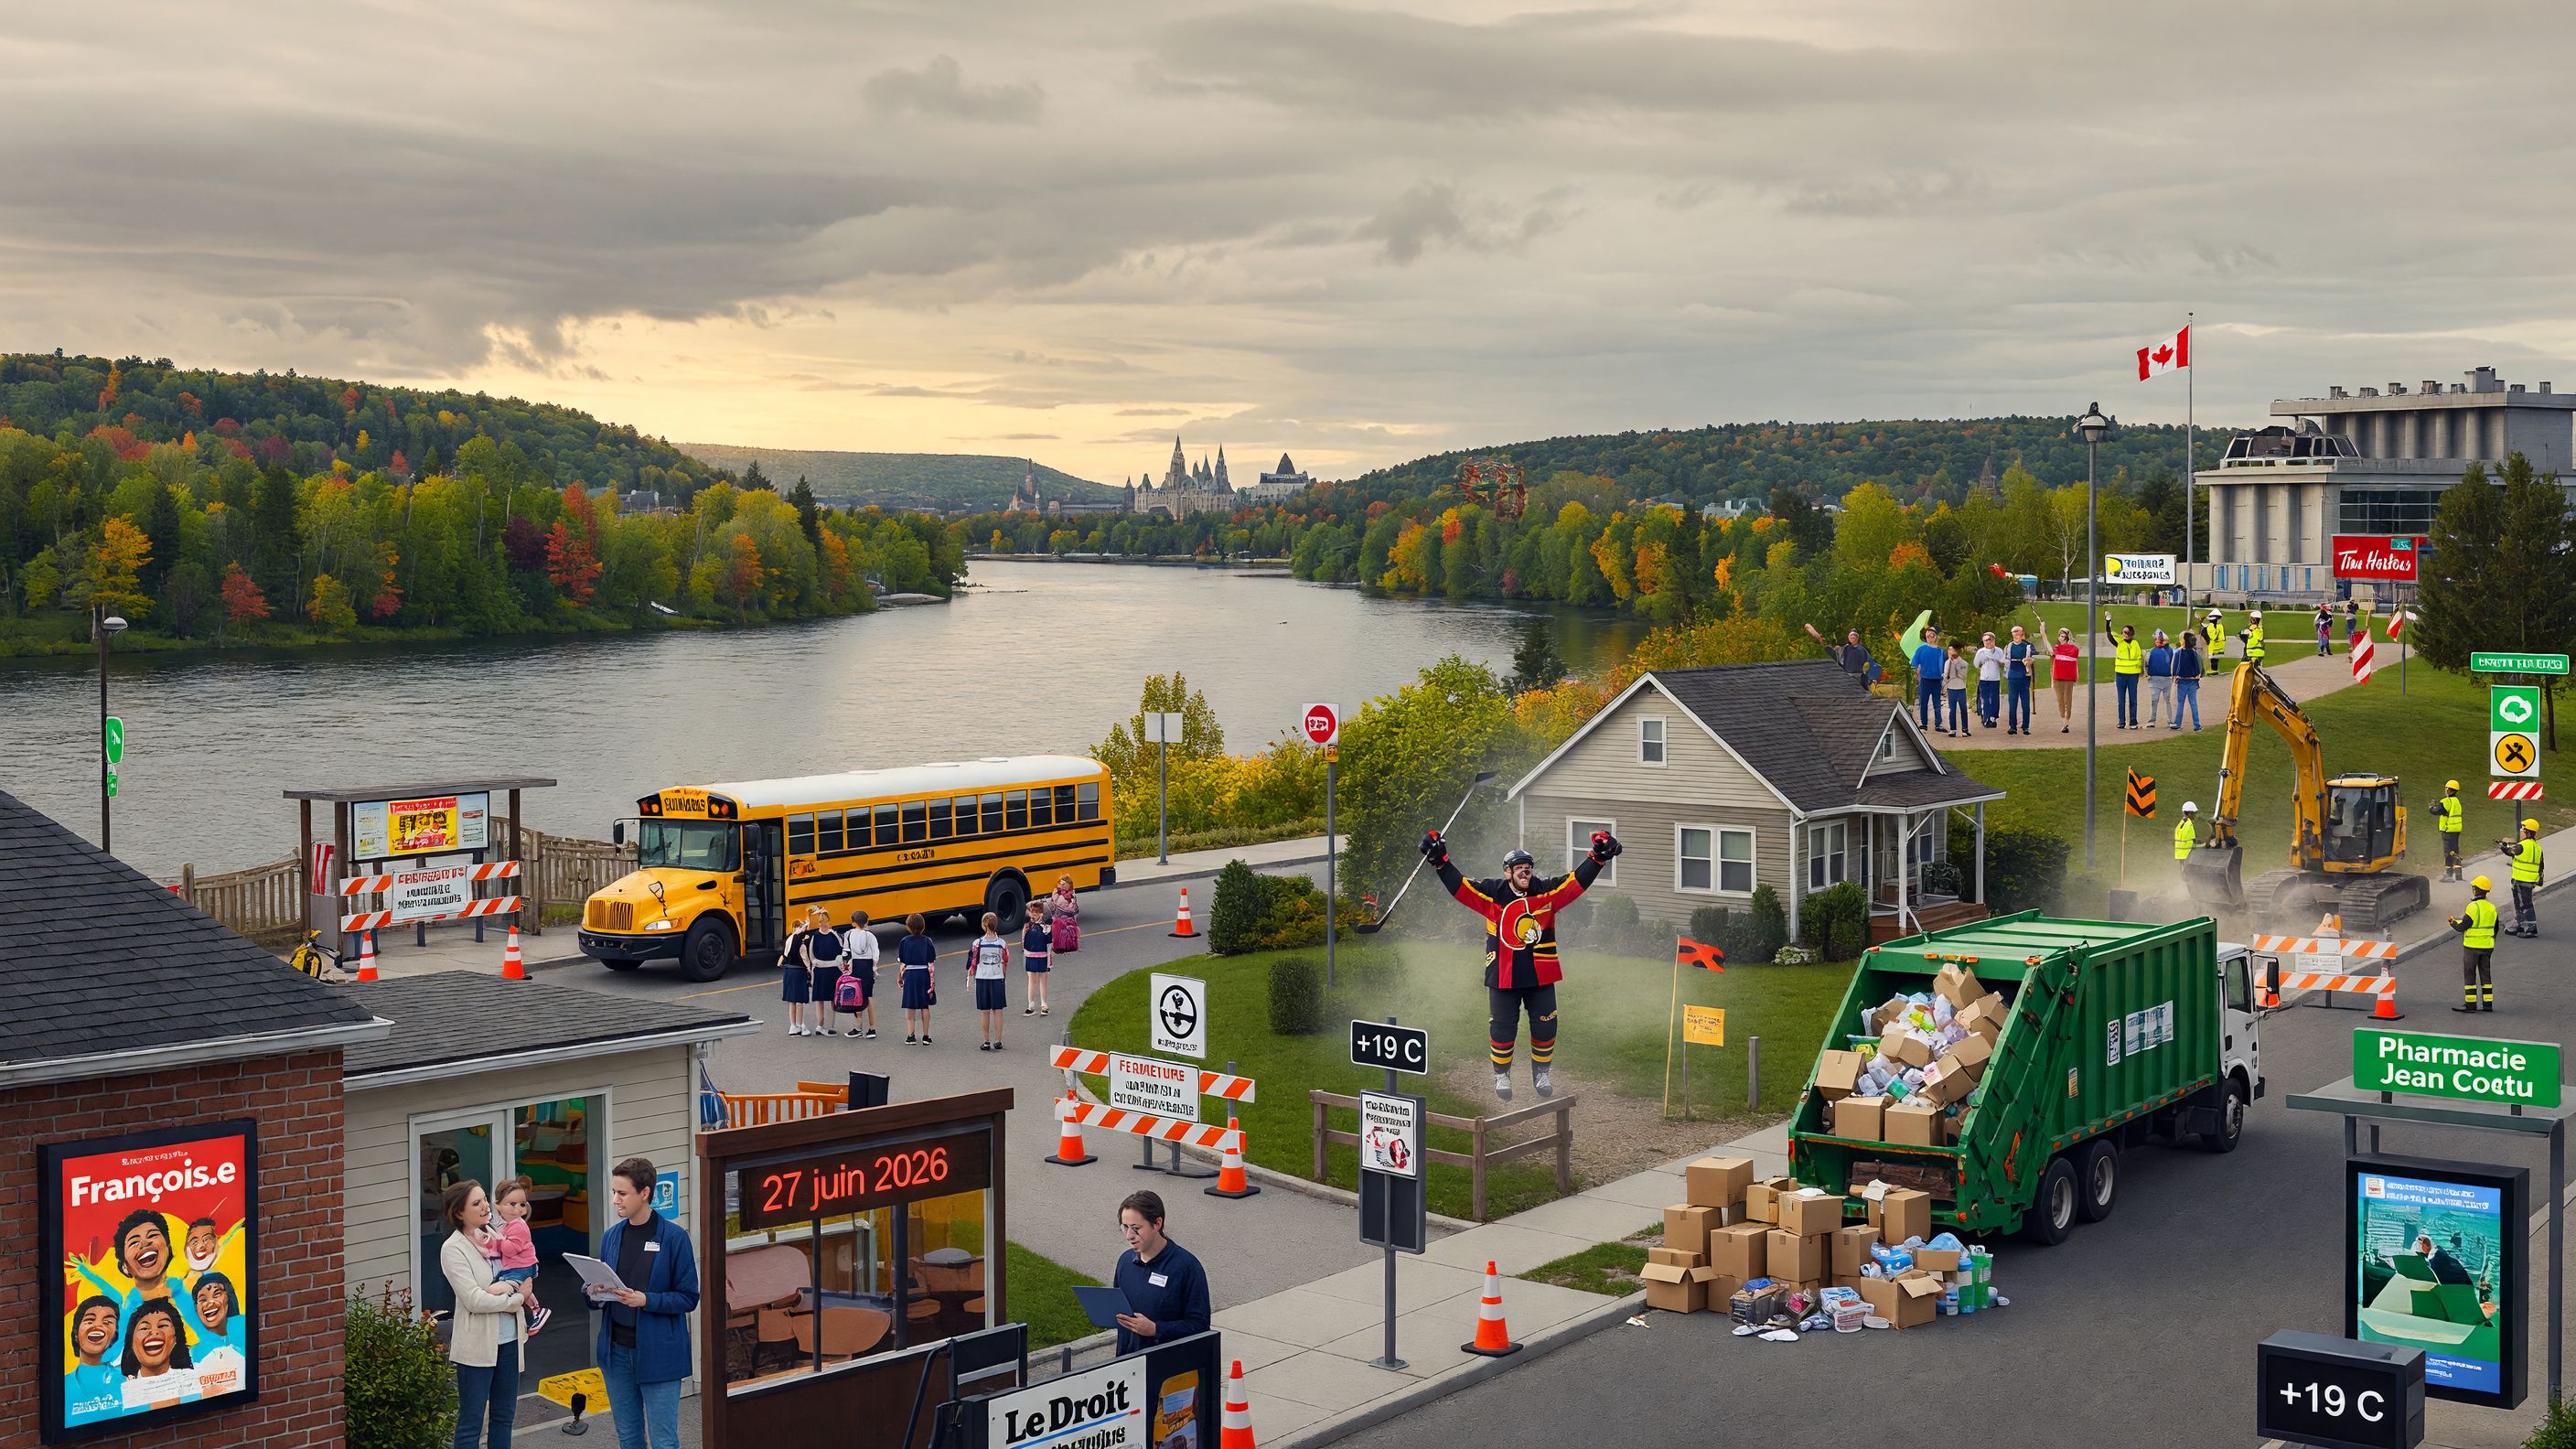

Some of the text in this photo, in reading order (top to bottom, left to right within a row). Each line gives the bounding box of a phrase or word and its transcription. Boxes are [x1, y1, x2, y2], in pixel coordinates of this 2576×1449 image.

[1357, 1035, 1422, 1063] +19 C
[2378, 1036, 2527, 1071] Pharmacie
[2380, 1063, 2444, 1089] Jean
[71, 1158, 236, 1207] François.e
[762, 1146, 949, 1212] 27 juin 2026
[1004, 1409, 1046, 1445] Le
[1048, 1379, 1130, 1433] Droit
[2280, 1382, 2385, 1422] +19 C
